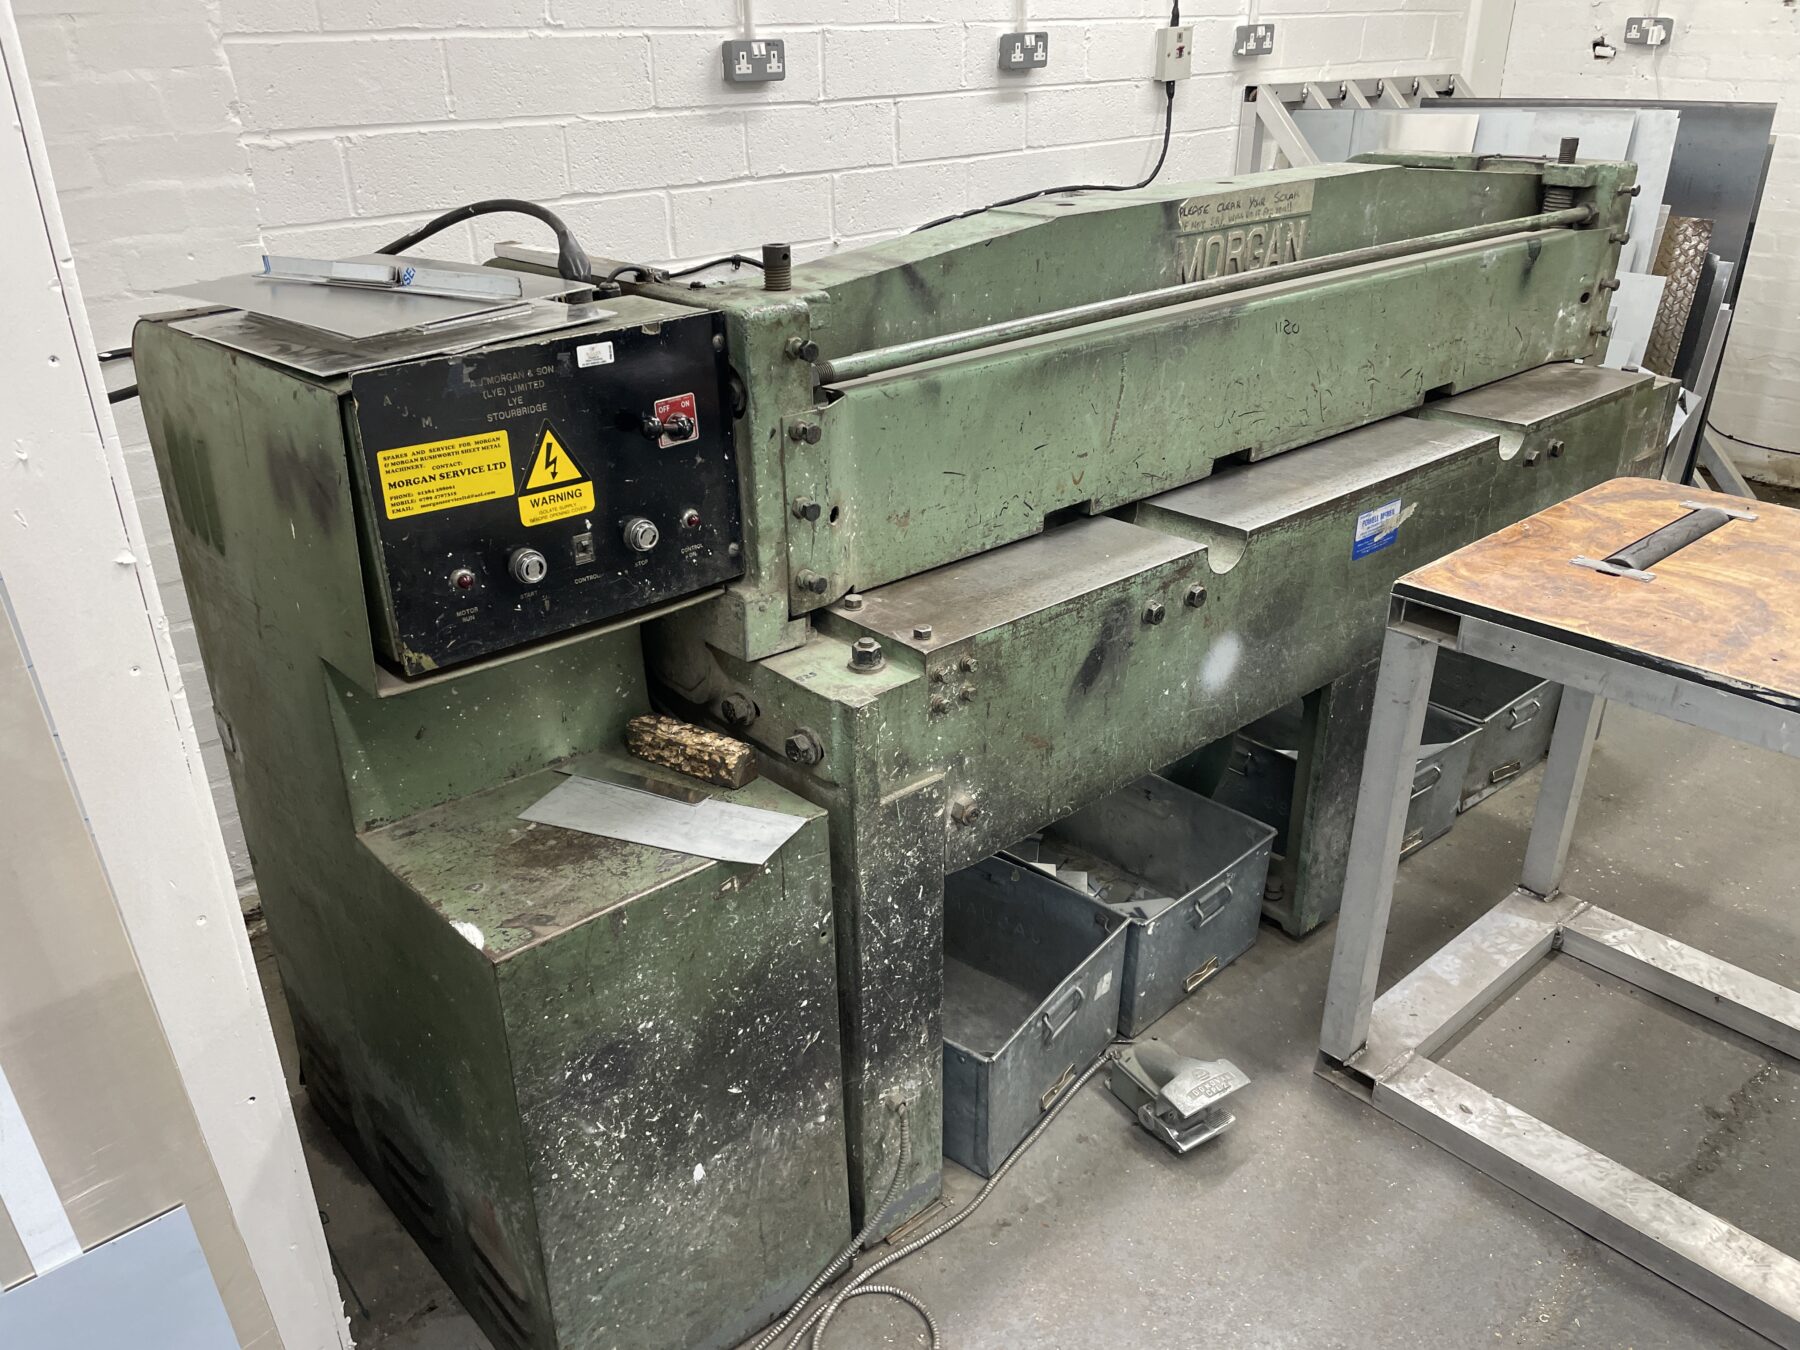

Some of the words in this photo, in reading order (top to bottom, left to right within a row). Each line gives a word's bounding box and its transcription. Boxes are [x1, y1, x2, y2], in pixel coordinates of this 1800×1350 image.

[1176, 219, 1307, 284] MORGAN
[487, 371, 525, 385] MORGAN
[536, 365, 554, 376] SON
[482, 387, 507, 400] (LYE)
[509, 380, 545, 394] LIMITED
[507, 396, 524, 407] LYE
[658, 404, 671, 414] OFF
[680, 400, 690, 408] ON
[486, 403, 548, 422] STOURBRIDGE
[383, 452, 408, 461] SPARES
[429, 444, 455, 453] SERVICE
[474, 436, 501, 445] MORGAN
[390, 457, 419, 467] MORGAN
[420, 450, 460, 461] RUSHWORTH
[460, 446, 480, 454] SHEET
[481, 443, 501, 451] METAL
[388, 474, 437, 490] MORGAN
[439, 466, 486, 481] SERVICE
[487, 461, 507, 472] LTD
[530, 488, 583, 508] WARNING
[681, 543, 703, 554] CONTROL
[634, 559, 649, 568] STOP
[574, 574, 601, 585] CONTROL
[519, 590, 538, 600] START
[456, 606, 479, 617] MOTOR
